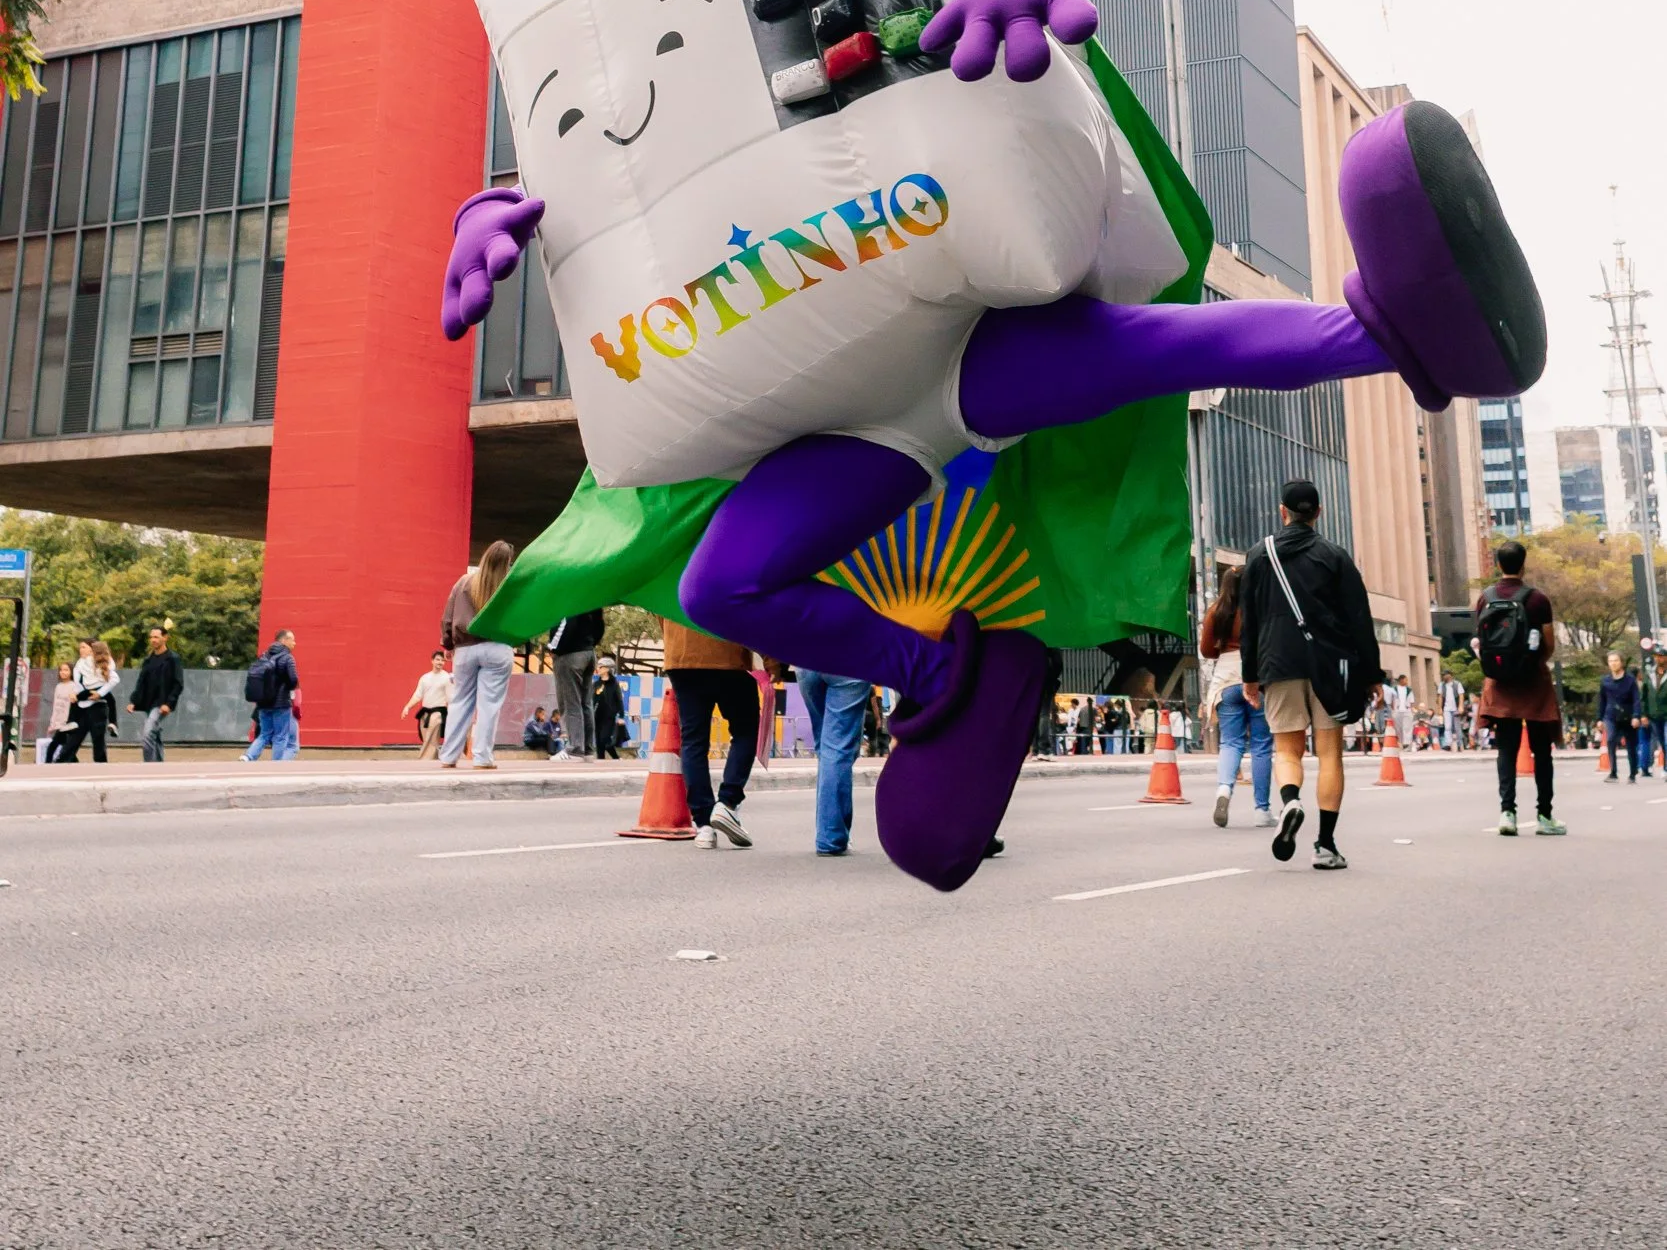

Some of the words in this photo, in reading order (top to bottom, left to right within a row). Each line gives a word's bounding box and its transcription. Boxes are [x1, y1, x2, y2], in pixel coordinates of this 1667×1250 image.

[811, 7, 822, 26] 0
[775, 60, 816, 82] BRANCO
[590, 173, 949, 384] VOTINHO
